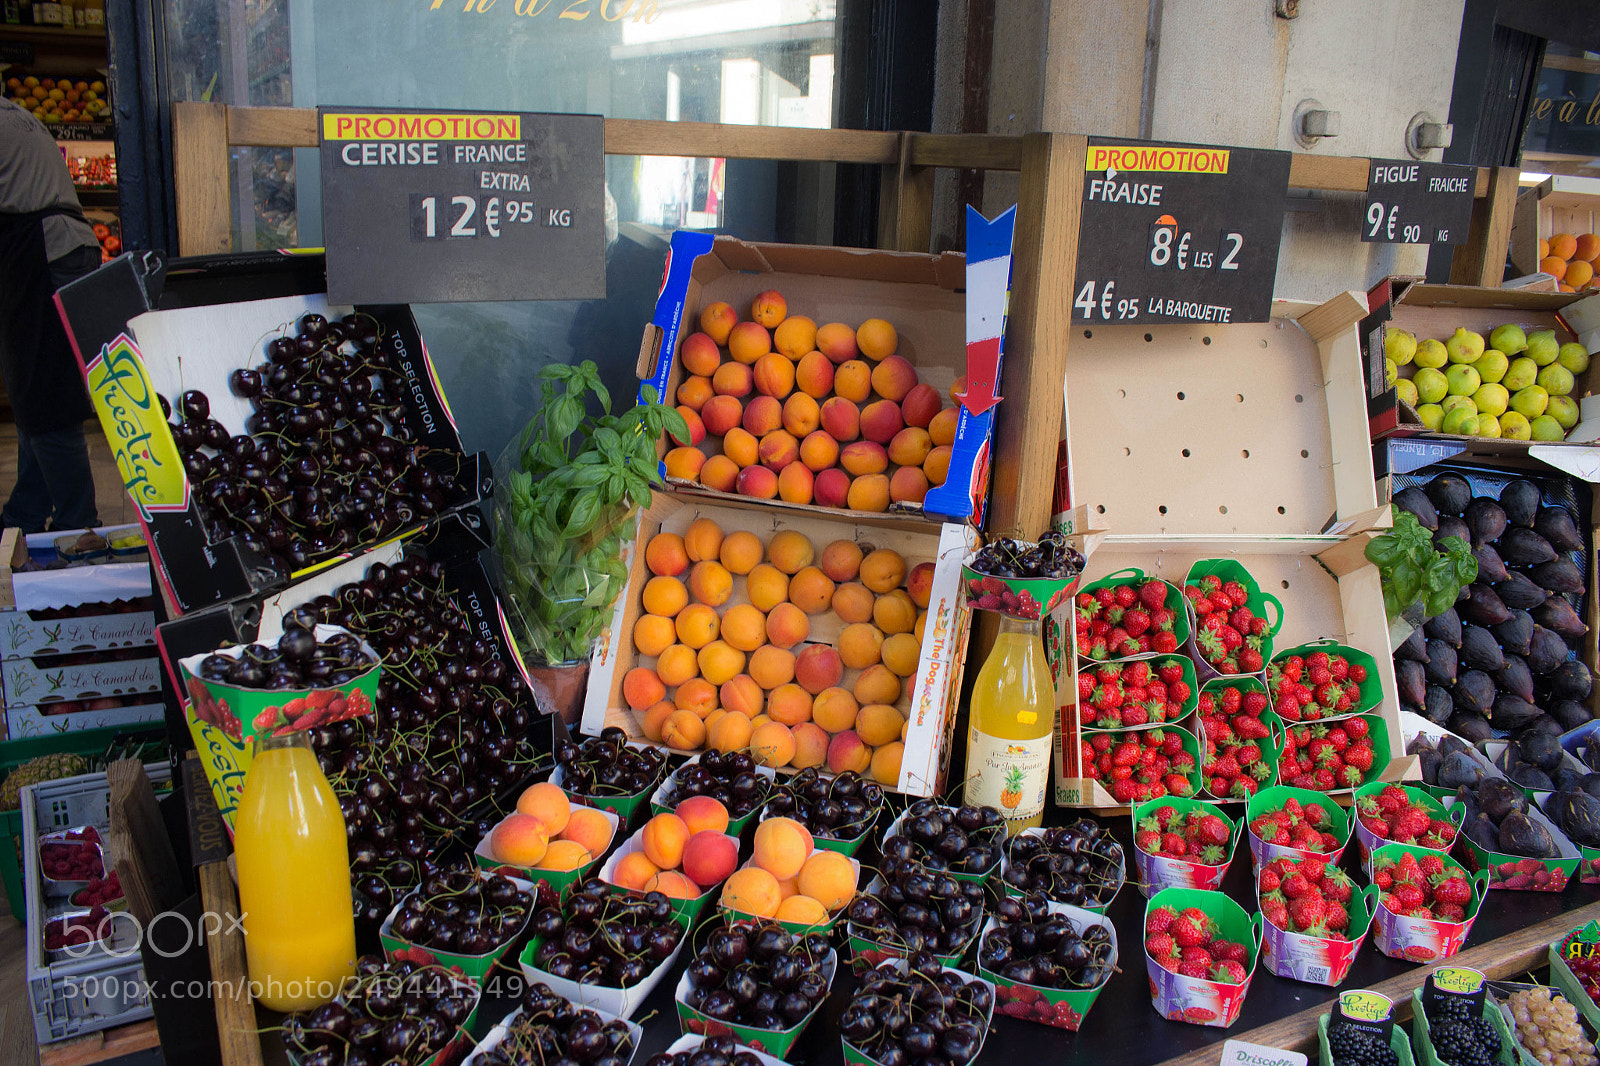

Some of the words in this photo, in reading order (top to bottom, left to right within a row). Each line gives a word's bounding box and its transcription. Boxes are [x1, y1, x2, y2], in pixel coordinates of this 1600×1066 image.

[1559, 89, 1581, 122] à
[337, 117, 517, 139] PROMOTION
[341, 143, 439, 166] CERISE
[454, 145, 527, 164] FRANCE
[1094, 149, 1227, 173] PROMOTION
[480, 171, 531, 193] EXTRA
[1374, 166, 1420, 184] FIGUE
[1428, 178, 1469, 193] FRAICHE
[1088, 179, 1163, 206] FRAISE
[549, 209, 571, 227] KG
[1437, 229, 1449, 242] KG
[1193, 251, 1214, 269] LES
[1220, 233, 1244, 270] 2
[1148, 297, 1164, 314] LA
[1165, 299, 1233, 323] BARQUETTE
[391, 330, 409, 361] TOP
[400, 361, 436, 435] SELECTION
[94, 343, 162, 522] Prestige
[468, 590, 483, 617] TOP
[88, 620, 135, 642] Canard
[932, 638, 945, 660] The
[91, 668, 138, 687] Canard
[1056, 785, 1080, 804] Fraises
[1432, 969, 1483, 994] Prestige
[1339, 995, 1391, 1022] Prestige
